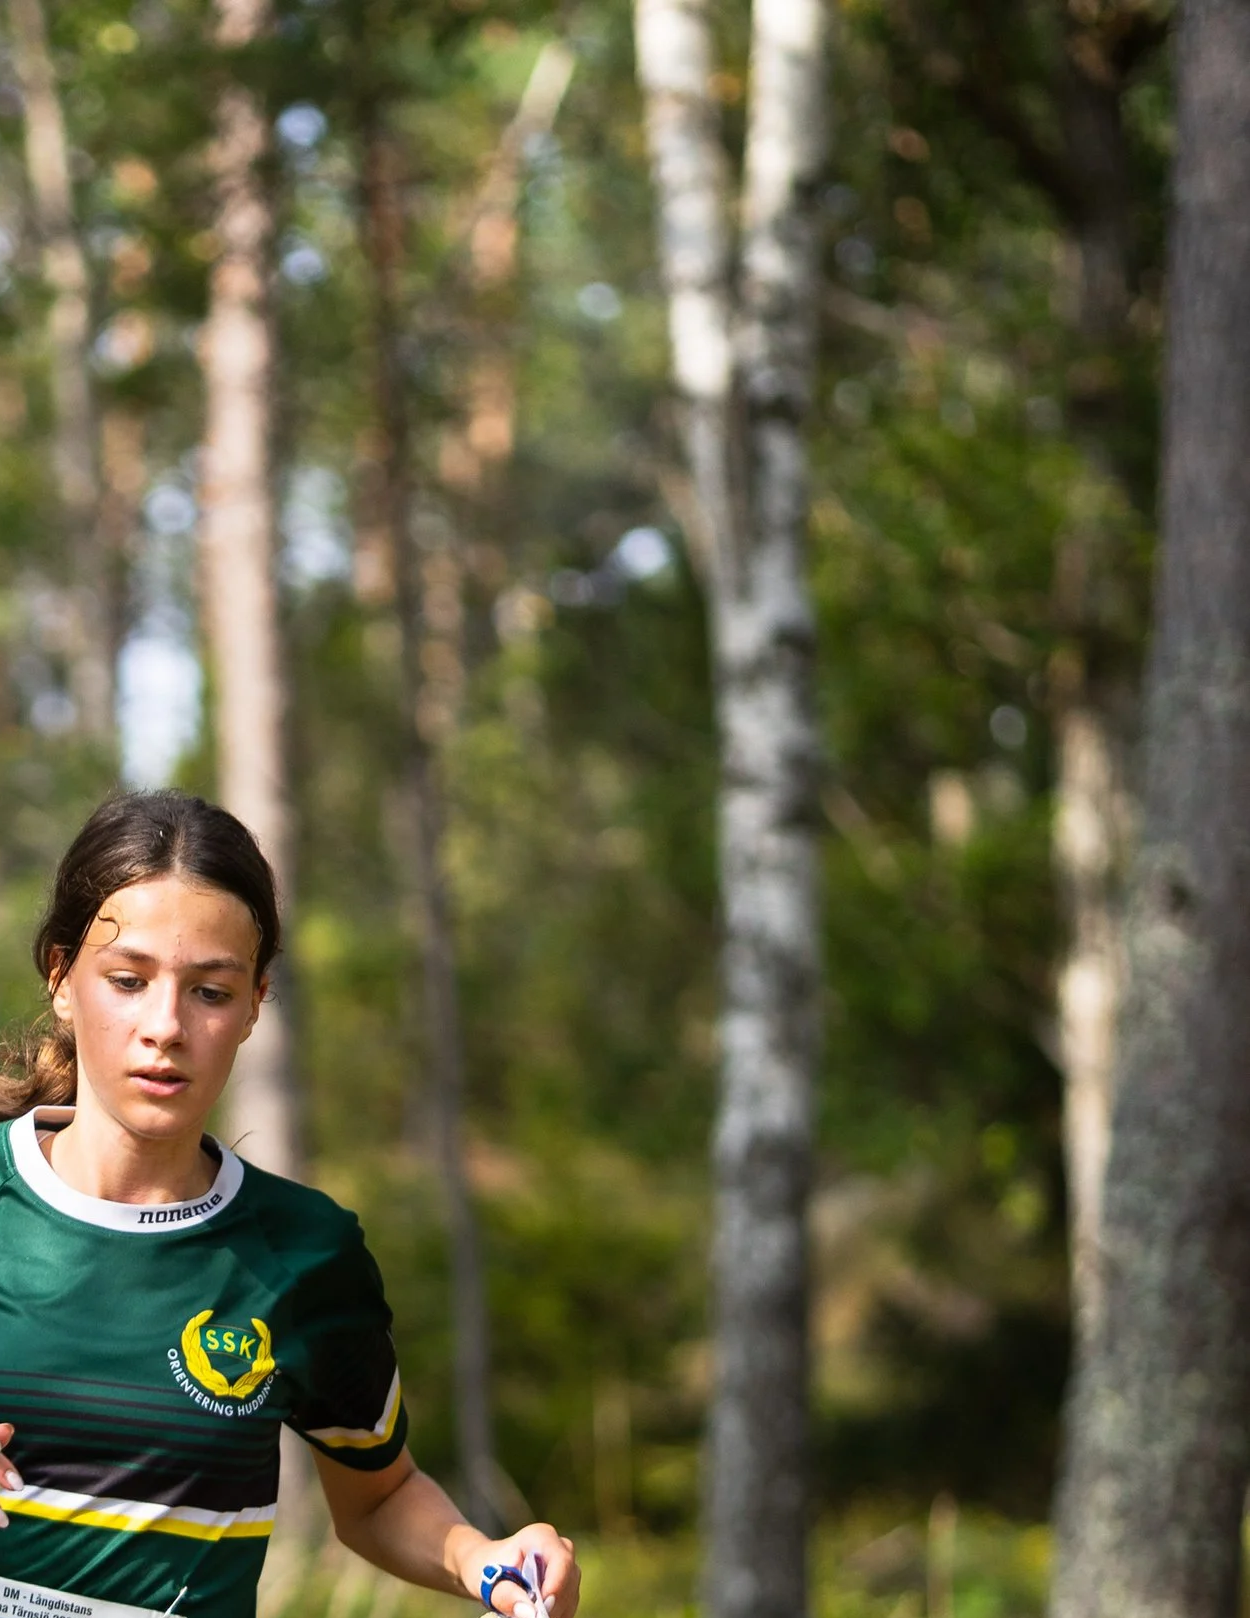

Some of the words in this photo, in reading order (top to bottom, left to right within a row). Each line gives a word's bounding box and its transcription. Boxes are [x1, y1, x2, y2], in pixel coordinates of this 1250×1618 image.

[137, 1193, 223, 1224] noname
[205, 1329, 256, 1359] SSK
[167, 1348, 234, 1417] ORIENTERING
[3, 1586, 20, 1600] DM
[30, 1592, 93, 1616] Långdistans
